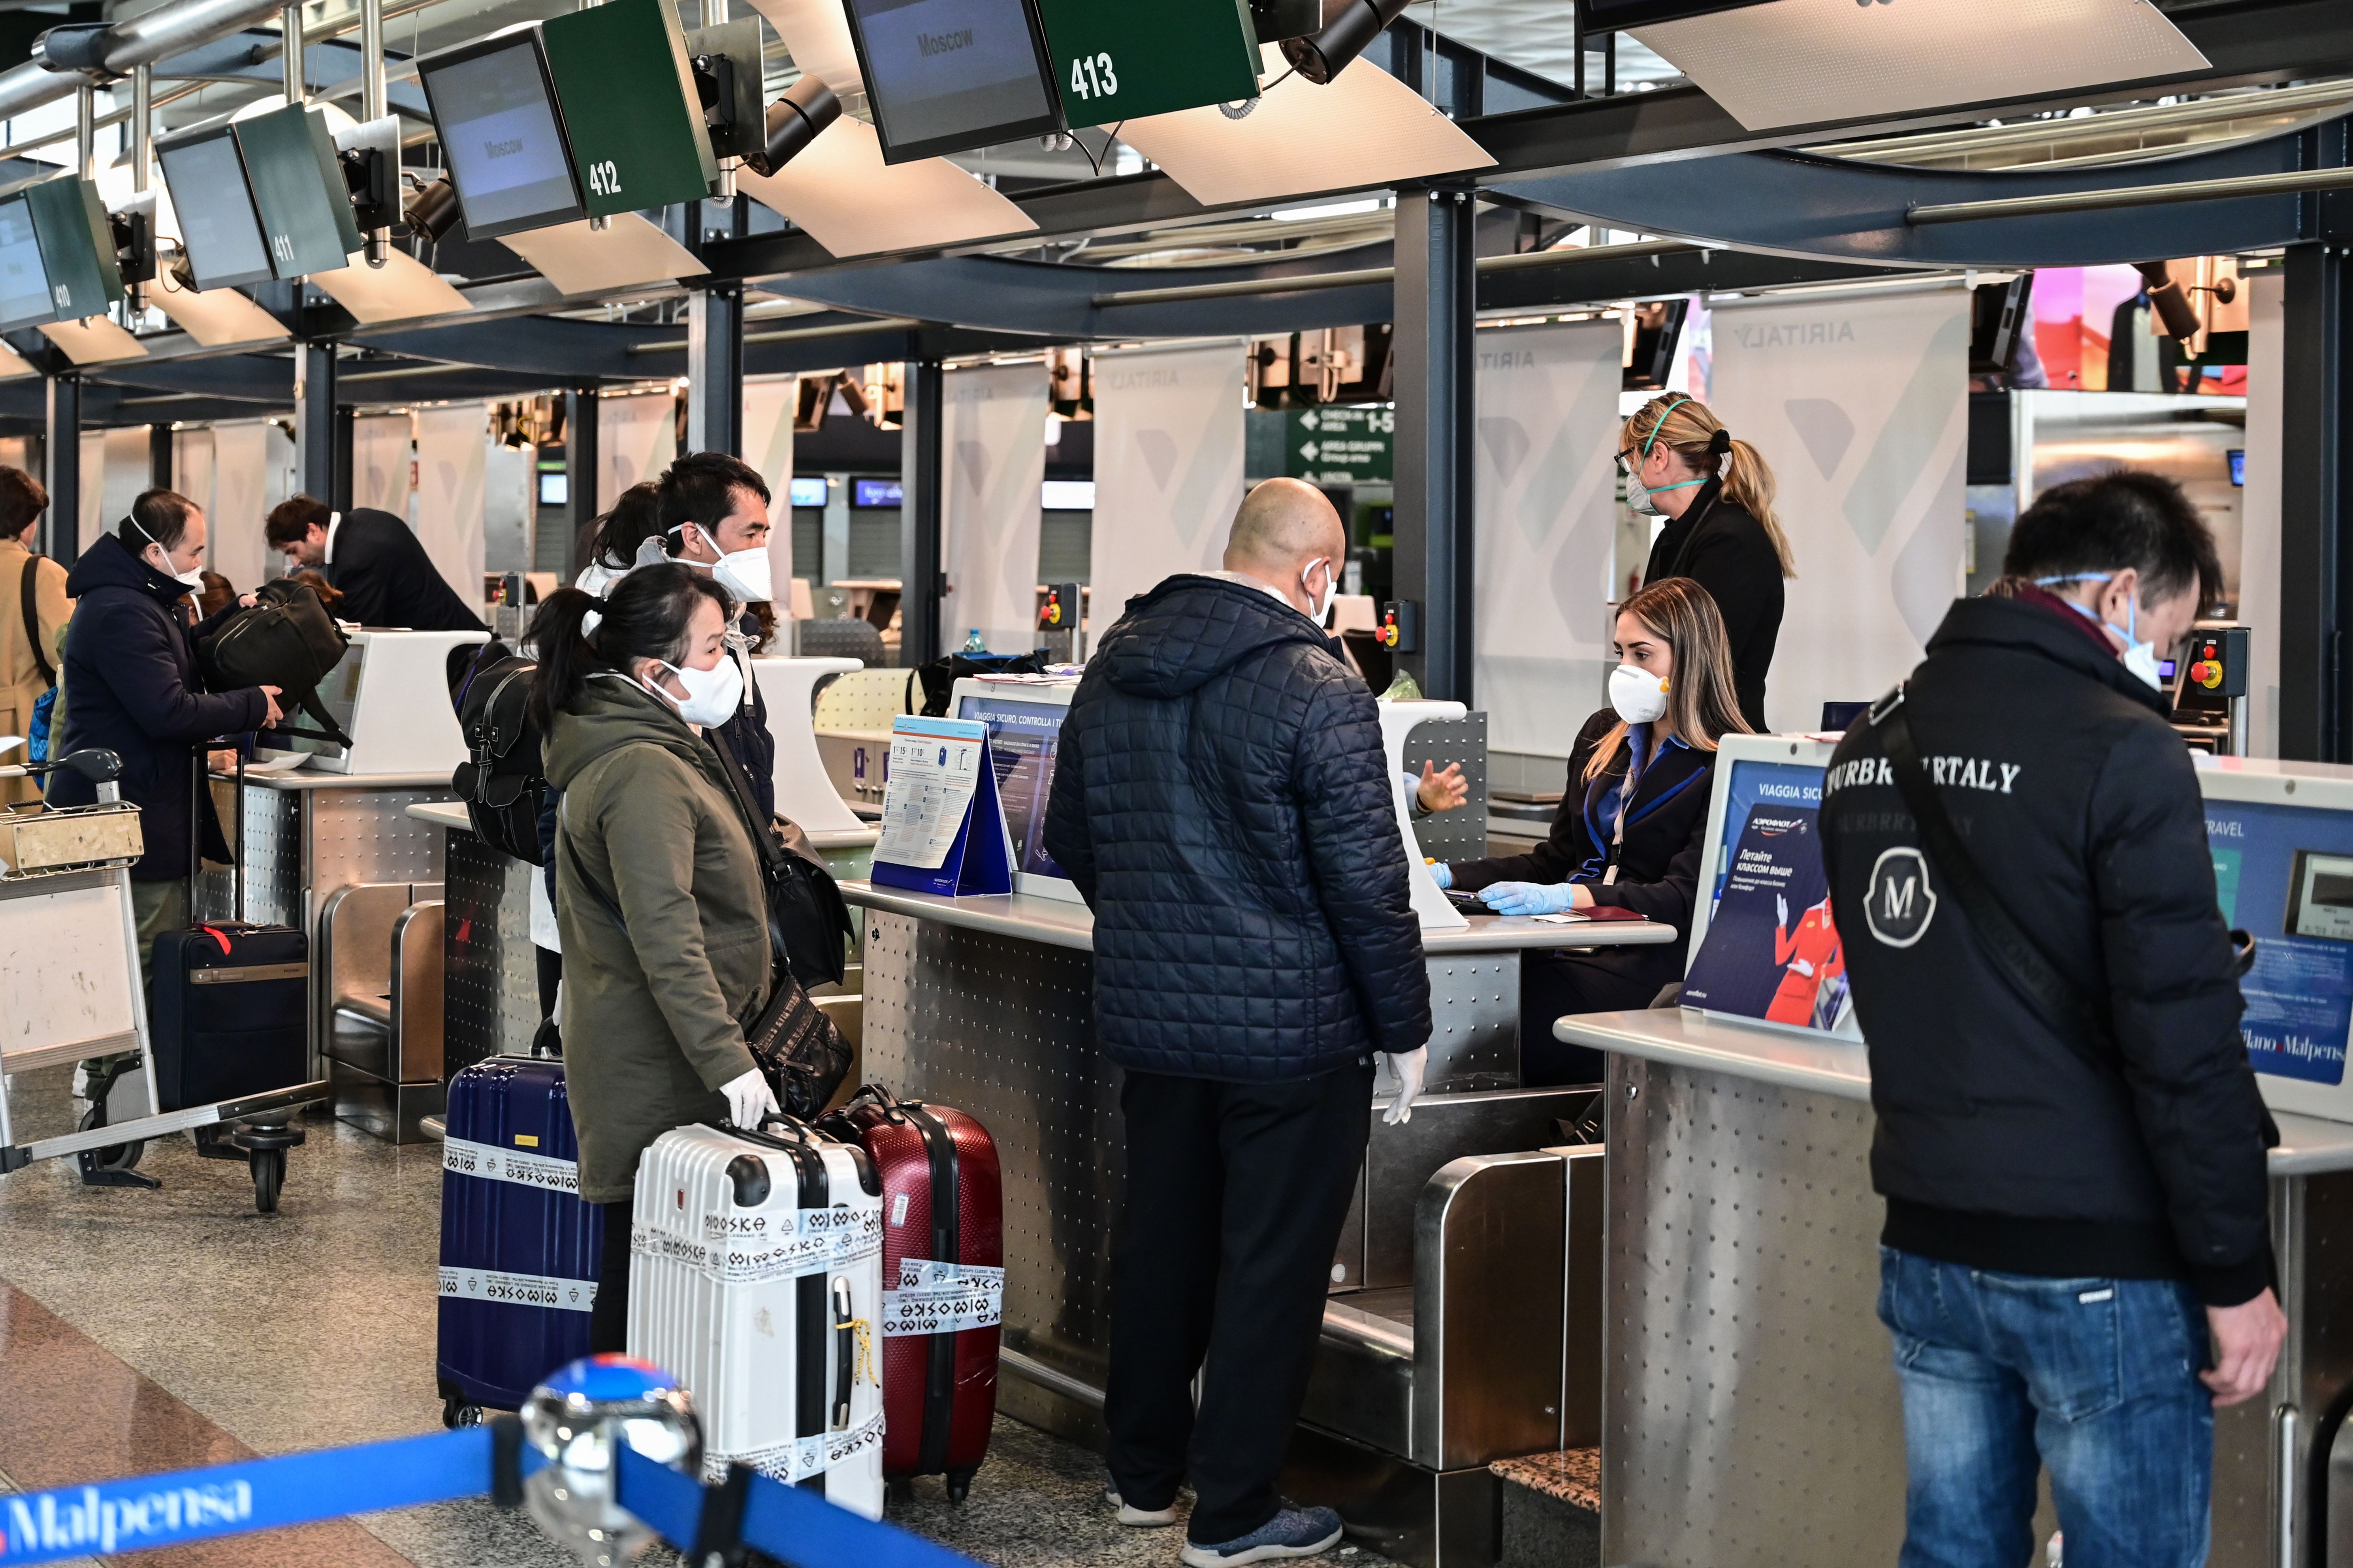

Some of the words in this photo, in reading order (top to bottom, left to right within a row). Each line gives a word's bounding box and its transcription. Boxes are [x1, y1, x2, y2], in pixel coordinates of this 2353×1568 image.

[917, 26, 973, 58] Moscow
[1071, 52, 1118, 100] 413
[485, 137, 523, 160] Moscow
[590, 160, 621, 196] 412
[275, 234, 295, 262] 411
[55, 284, 72, 308] 410
[974, 711, 995, 722] VIAGGIA
[996, 713, 1017, 725] SICURO,
[1018, 716, 1051, 727] CONTROLLA
[900, 746, 905, 755] 15
[1759, 783, 1800, 799] VIAGGIA
[1739, 848, 1772, 863] Летайте
[1736, 862, 1769, 874] классом
[1769, 865, 1793, 877] выше
[1883, 875, 1917, 919] M
[2240, 1028, 2277, 1051] ilano
[6, 1479, 253, 1554] Malpensa
